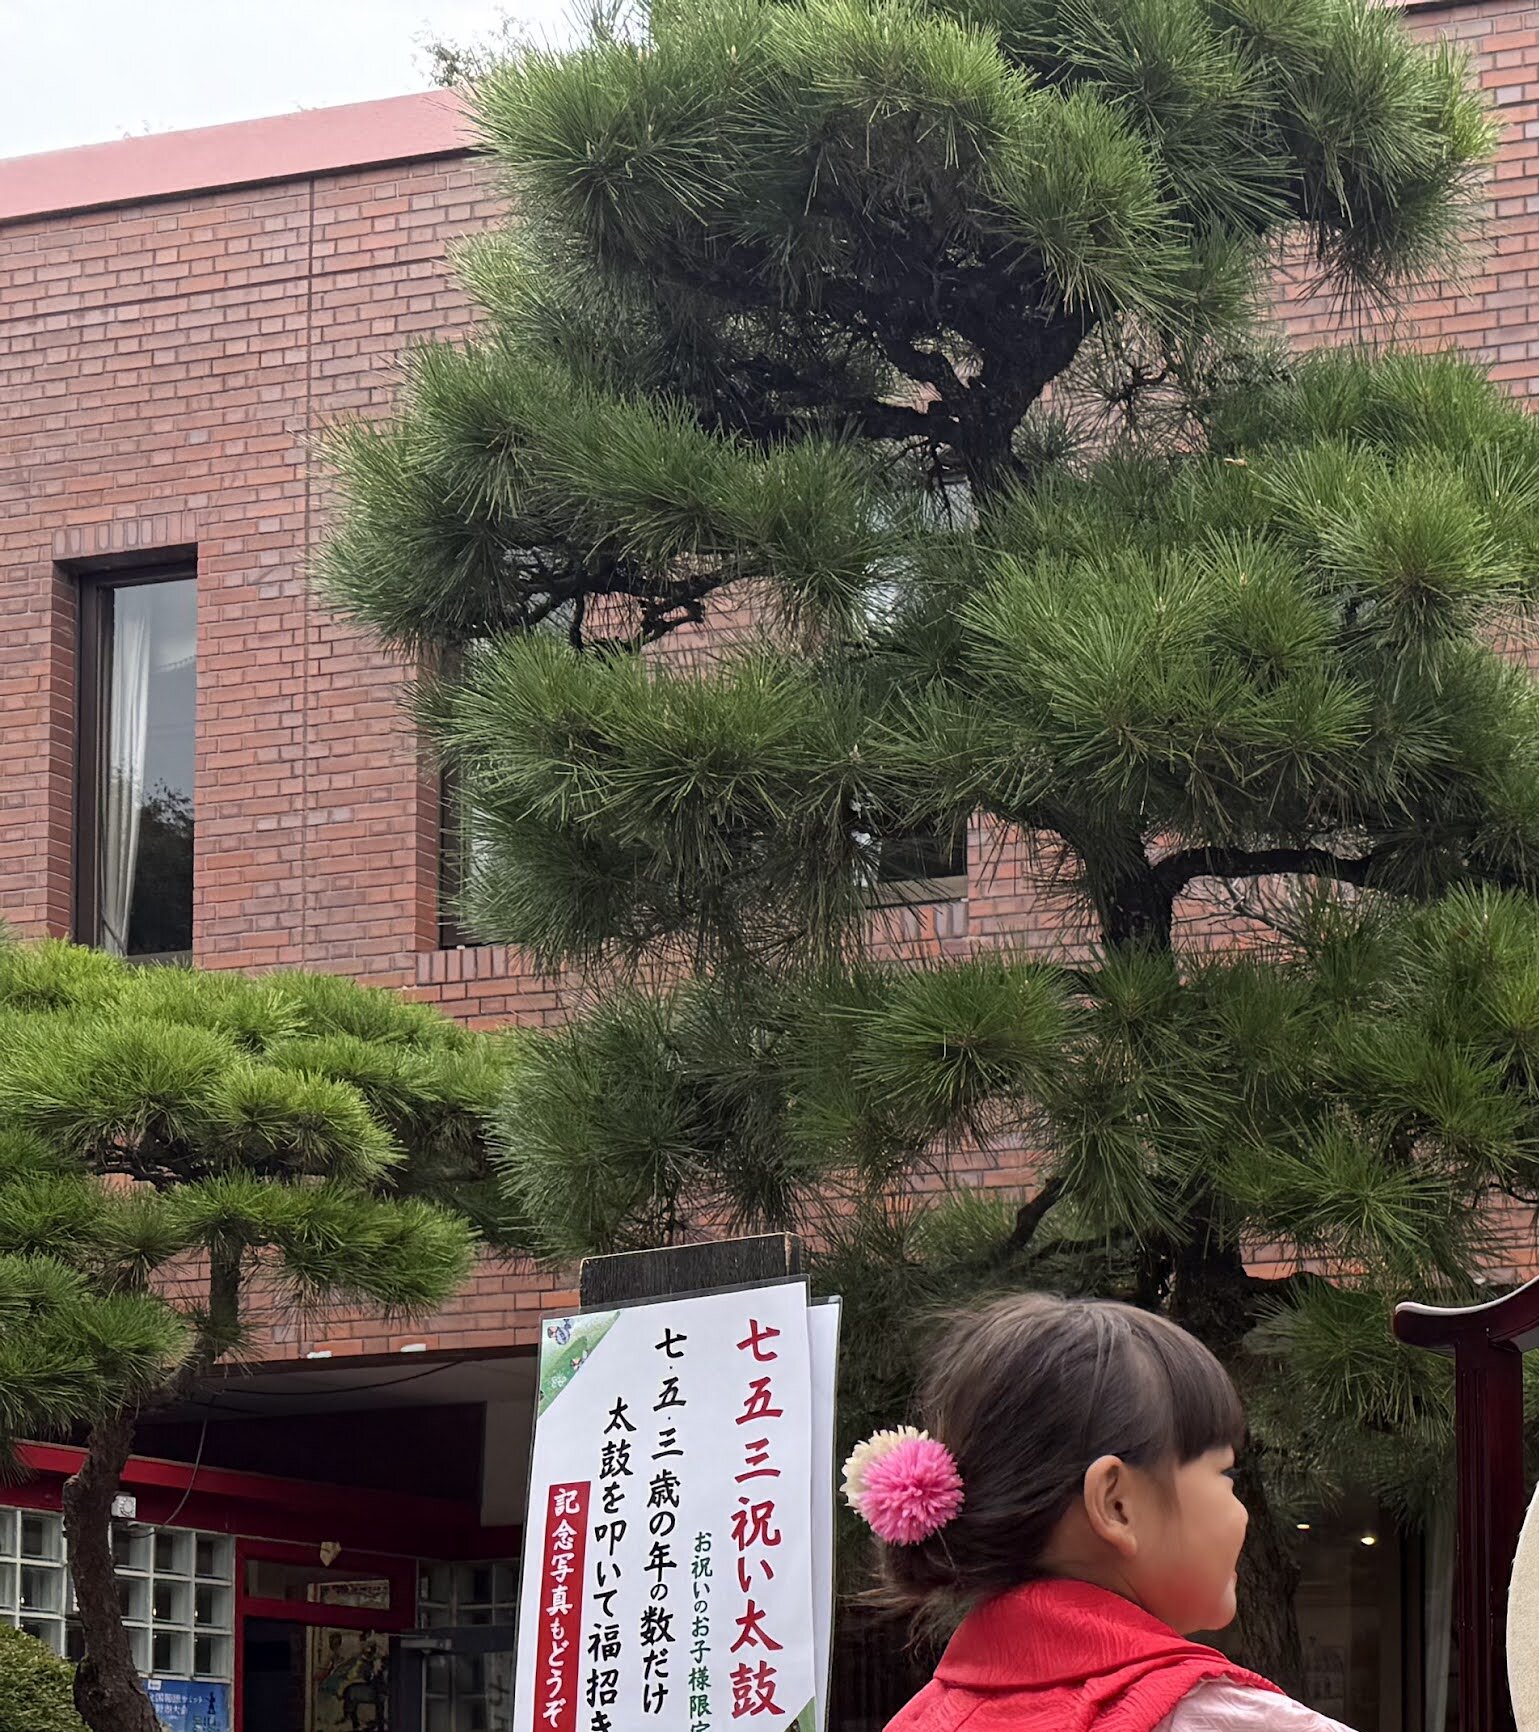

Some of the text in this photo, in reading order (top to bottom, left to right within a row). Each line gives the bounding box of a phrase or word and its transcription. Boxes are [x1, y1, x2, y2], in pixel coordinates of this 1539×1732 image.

[542, 1489, 581, 1728] 記念写真もどうぞ
[730, 1319, 785, 1719] 七五三祝い太鼓
